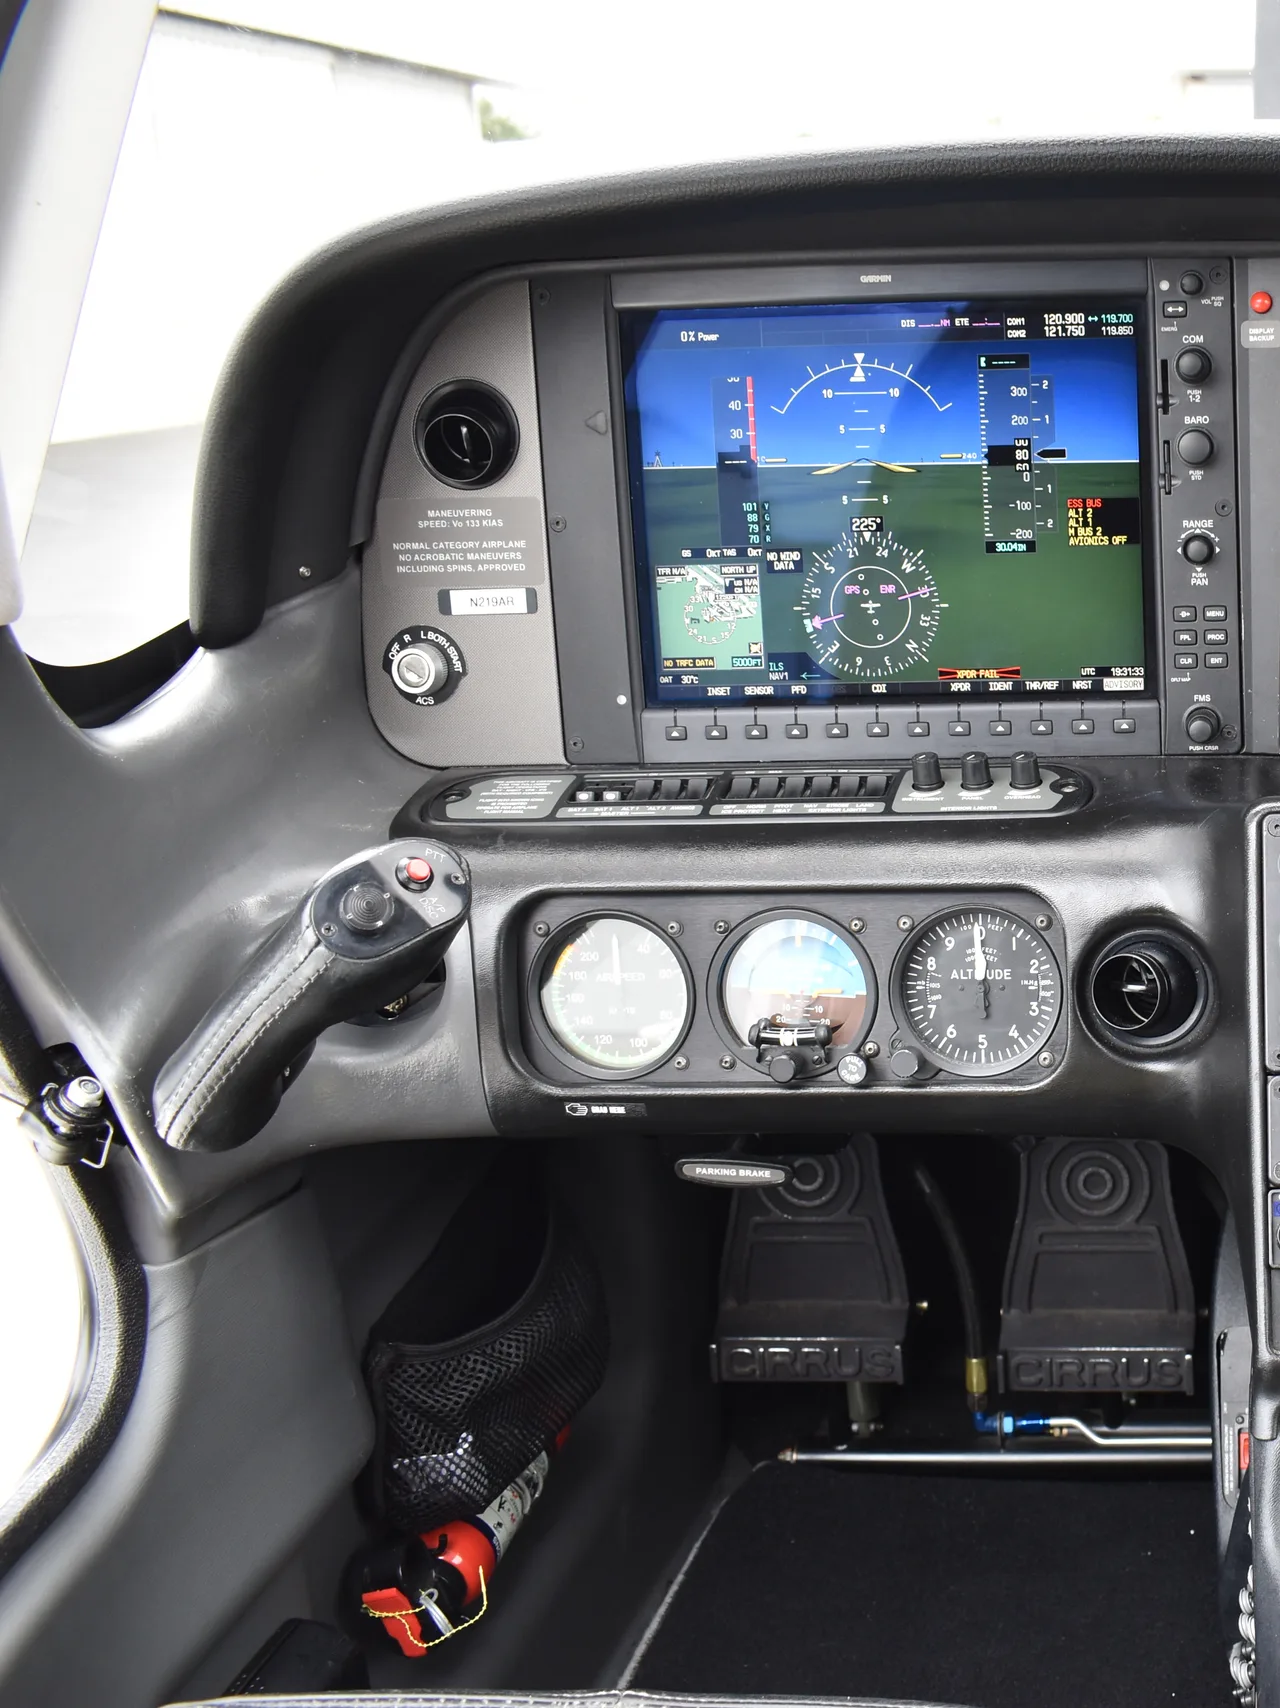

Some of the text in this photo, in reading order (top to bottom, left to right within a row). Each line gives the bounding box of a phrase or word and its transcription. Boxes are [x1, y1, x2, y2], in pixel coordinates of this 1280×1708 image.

[860, 275, 891, 283] GARMIN
[1044, 313, 1085, 324] 120.900
[1101, 314, 1133, 323] 119.700
[681, 331, 719, 341] 0% Power
[1044, 326, 1085, 337] 121.750
[1101, 326, 1133, 335] 119.850
[1184, 416, 1209, 424] BARO
[1068, 499, 1102, 507] ESS BUS
[428, 509, 492, 517] MANEUVERING
[1069, 509, 1093, 517] ALT 2
[483, 519, 503, 527] KIAS
[1088, 518, 1092, 526] 1
[1183, 520, 1214, 528] RANGE
[1069, 527, 1102, 536] M BUS 2
[482, 540, 526, 548] AIRPLANE
[1069, 536, 1127, 546] AVIONICS OFF
[414, 553, 464, 561] ACROBATIC
[467, 552, 522, 560] MANEUVERS
[397, 565, 444, 573] INCLUDING
[478, 564, 526, 572] APPROVED
[403, 634, 411, 643] R
[421, 631, 449, 649] L BOTH
[389, 643, 400, 660] OFF
[447, 645, 462, 673] START
[1111, 667, 1144, 676] 19:31:33
[872, 684, 887, 693] CDI
[951, 683, 970, 691] XPDR
[989, 682, 1013, 691] IDENT
[1025, 681, 1059, 690] TMR/REF
[1073, 681, 1092, 689] NRST
[1104, 680, 1143, 689] ADVISORY
[707, 687, 730, 696] INSET
[744, 687, 774, 695] SENSOR
[791, 686, 807, 694] PFD
[416, 696, 434, 705] ACS
[945, 937, 955, 951] 9
[927, 957, 937, 970] 8
[1029, 959, 1039, 973] 2
[951, 969, 1012, 979] ALTUDE
[927, 1005, 937, 1018] 7
[1029, 1002, 1039, 1016] 3
[946, 1024, 956, 1037] 6
[1008, 1024, 1019, 1037] 4
[594, 1035, 612, 1045] 120
[630, 1038, 647, 1047] 100
[978, 1035, 988, 1048] 5
[727, 1345, 896, 1378] CIRRUS
[1011, 1355, 1182, 1388] CIRRUS
